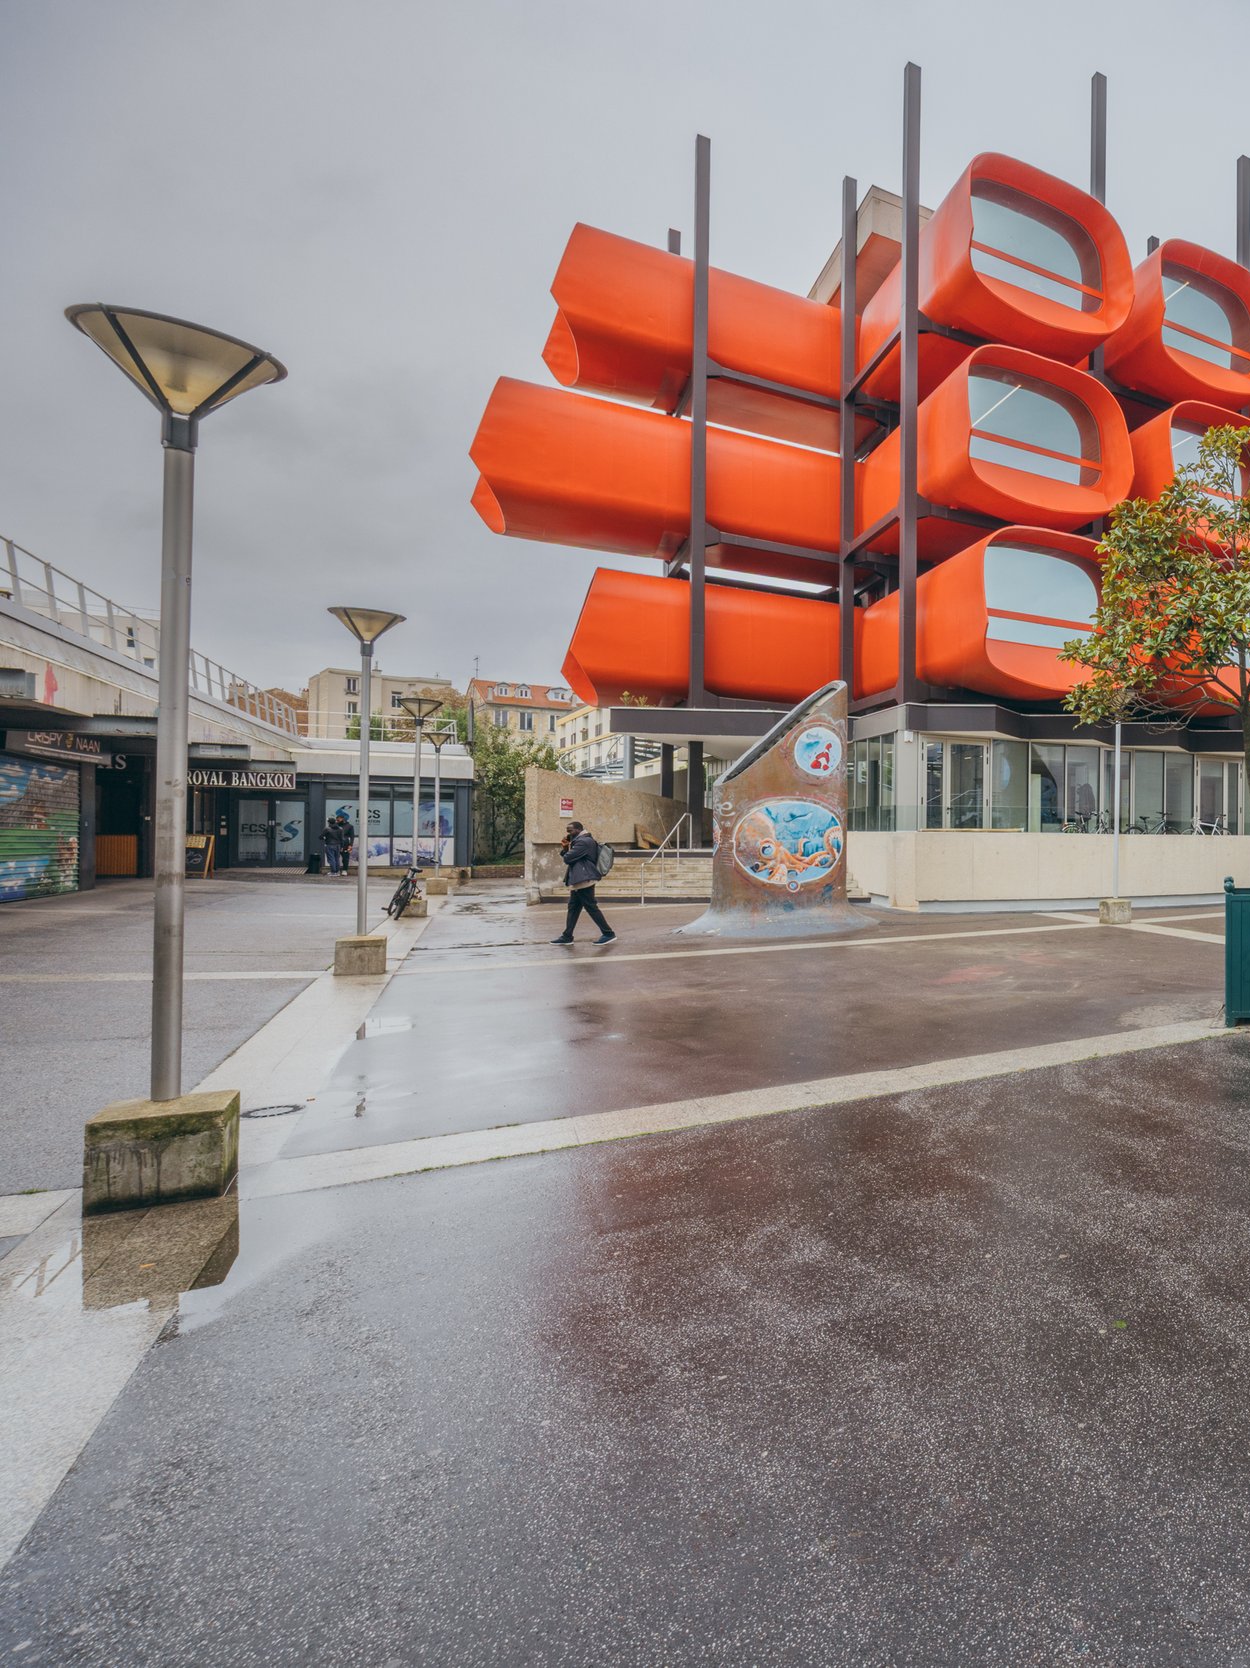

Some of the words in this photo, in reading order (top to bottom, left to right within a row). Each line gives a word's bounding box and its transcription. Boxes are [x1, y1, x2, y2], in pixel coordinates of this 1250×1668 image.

[75, 737, 101, 753] NAAN
[231, 771, 292, 788] BANGKOK
[241, 823, 267, 833] FCS
